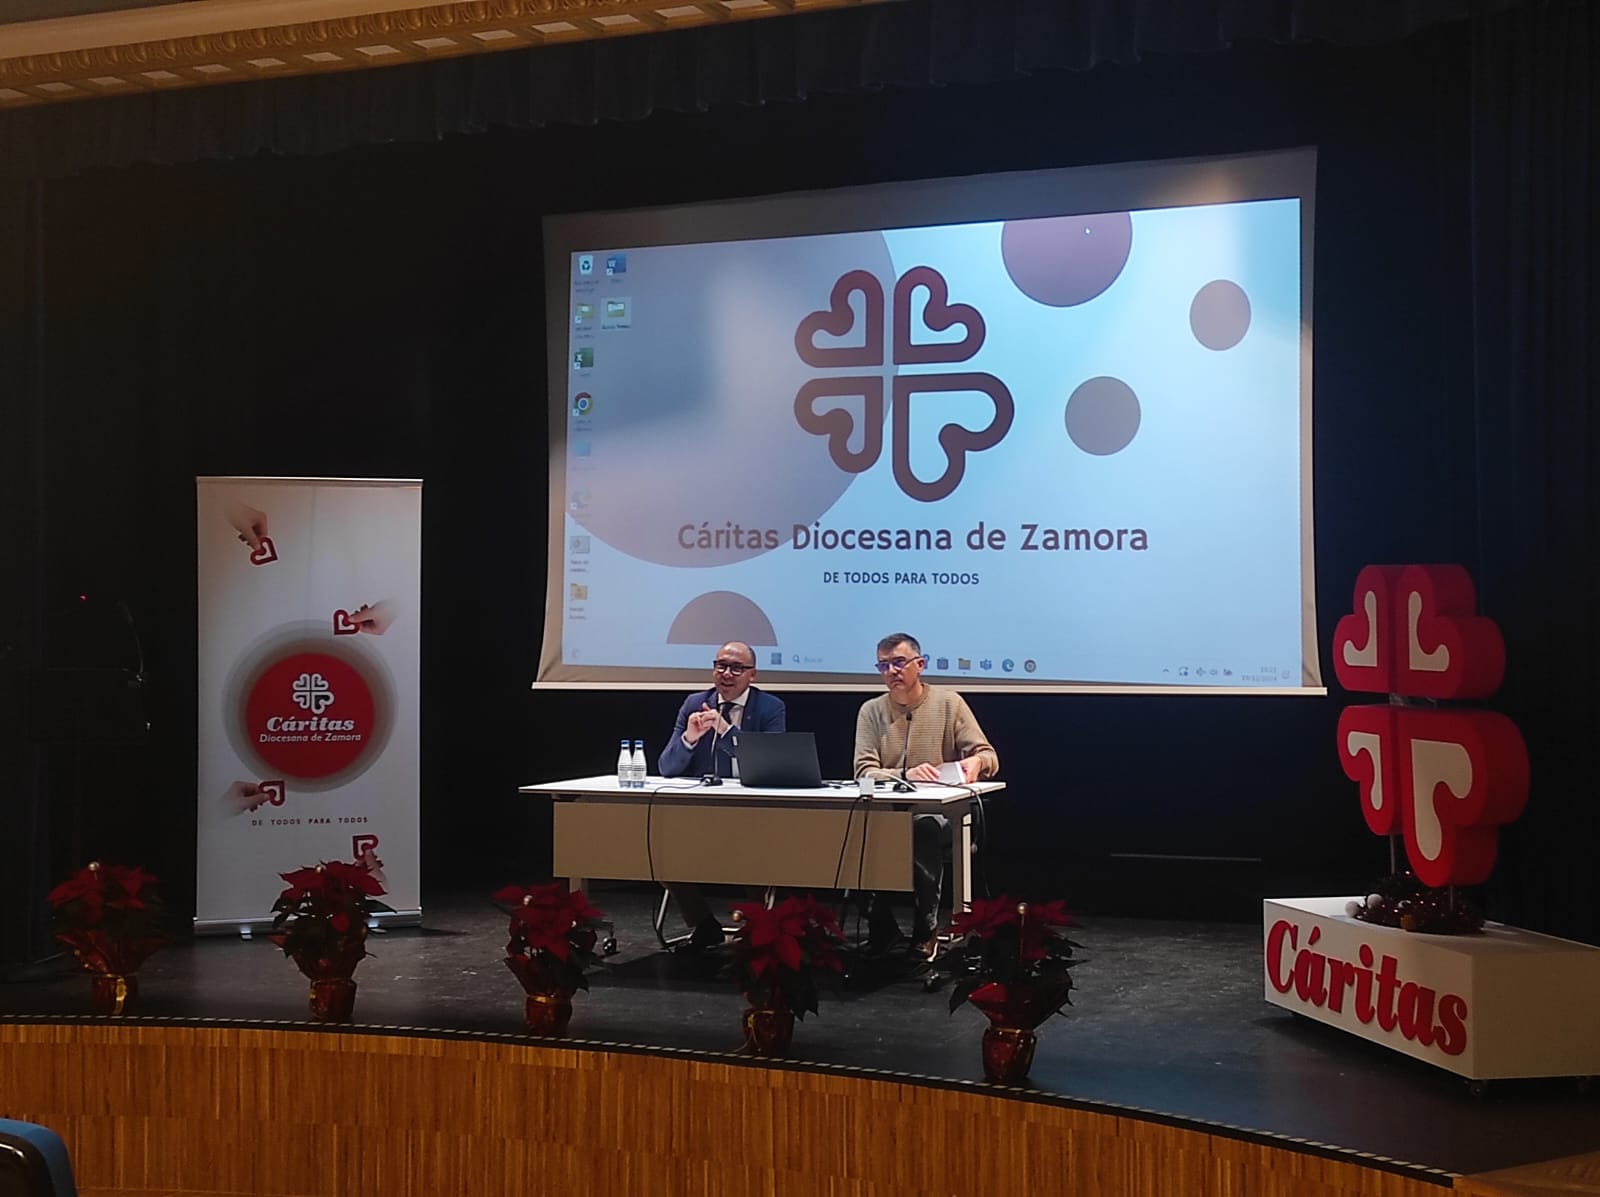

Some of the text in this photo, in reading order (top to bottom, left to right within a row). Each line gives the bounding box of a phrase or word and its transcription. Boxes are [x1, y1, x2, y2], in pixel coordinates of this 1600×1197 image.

[678, 521, 1149, 550] Cáritas Diocesana de Zamora
[824, 572, 980, 585] DE TODOS PARA TODOS
[267, 716, 355, 732] Cáritas
[259, 732, 361, 742] Diocesana de Zamora
[271, 818, 301, 826] TODOS
[308, 817, 331, 825] PARA
[1266, 919, 1467, 1056] Cáritas
